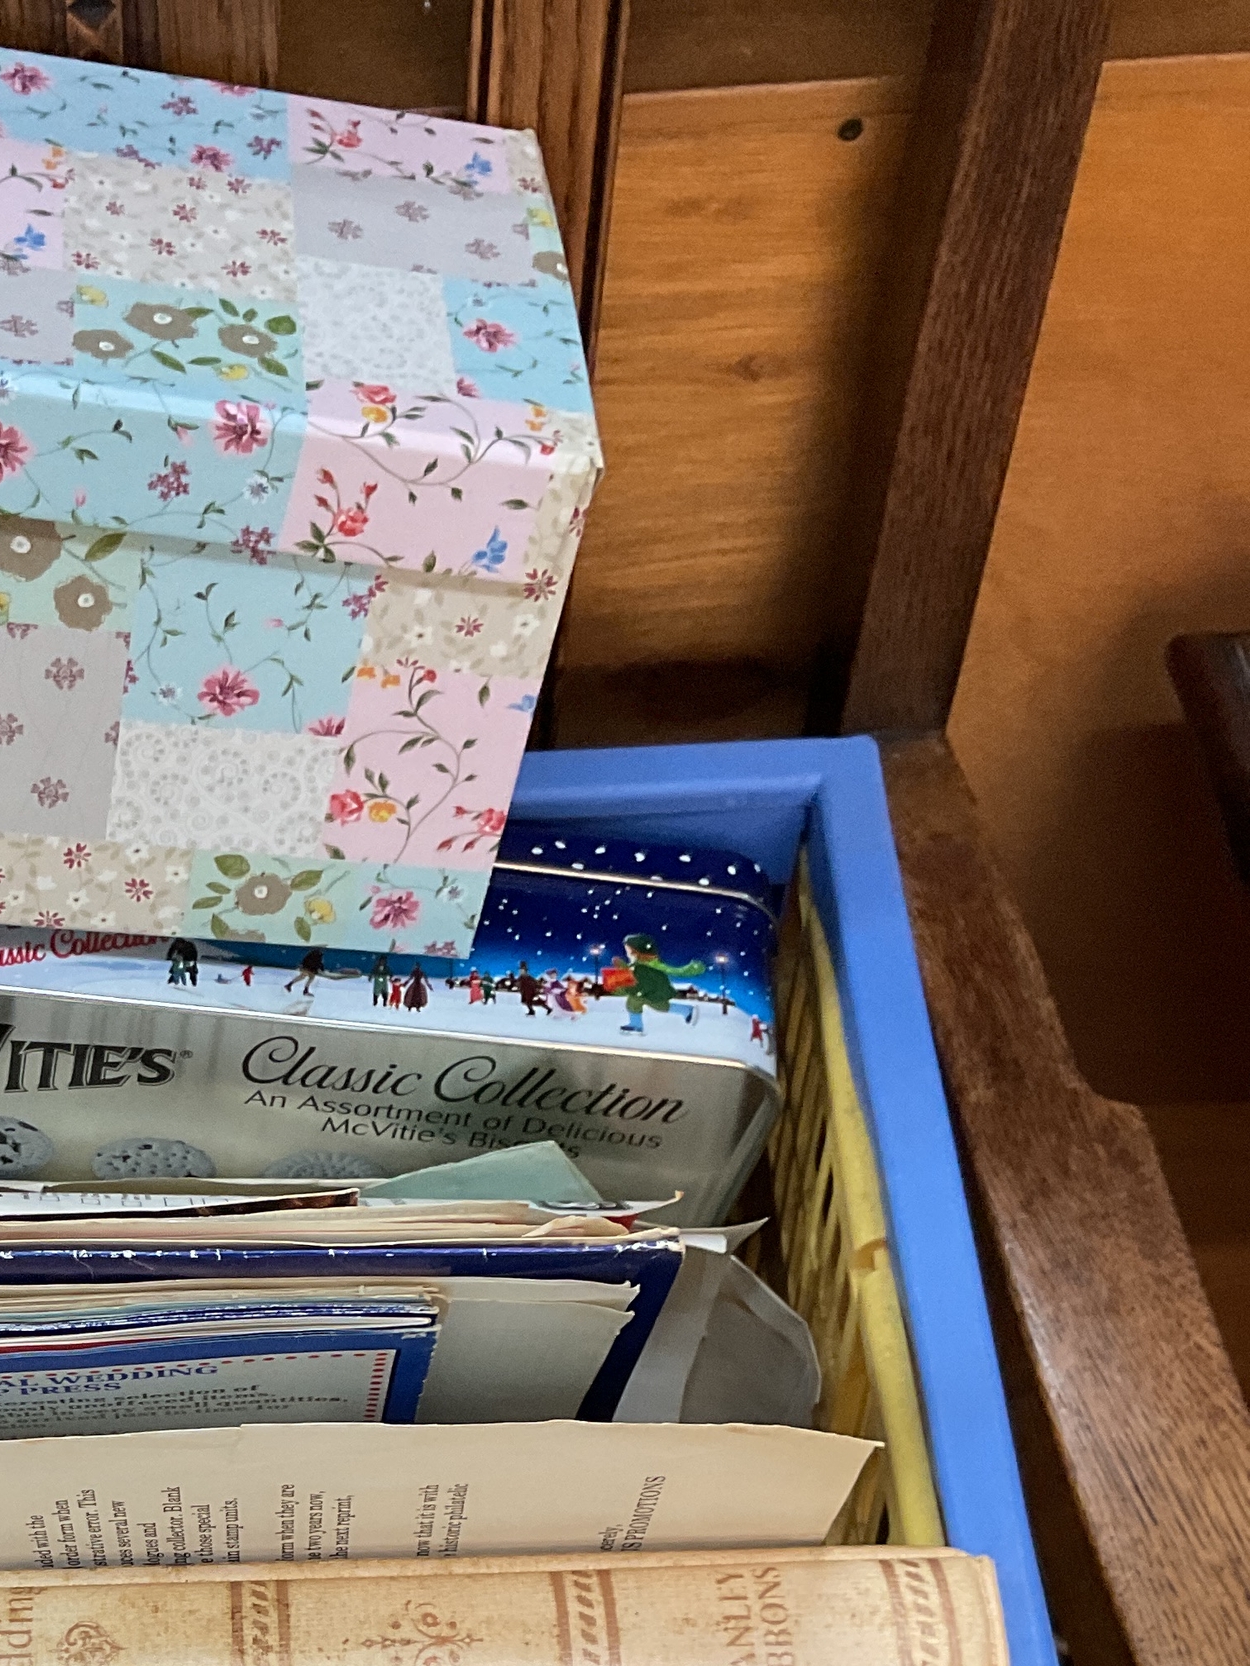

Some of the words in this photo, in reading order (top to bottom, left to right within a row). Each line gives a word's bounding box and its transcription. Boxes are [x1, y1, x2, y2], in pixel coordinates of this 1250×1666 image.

[241, 1035, 423, 1096] Classic
[433, 1055, 690, 1125] Collection
[244, 1090, 287, 1111] An
[296, 1094, 470, 1130] Assortment
[483, 1113, 512, 1133] of
[522, 1117, 663, 1151] Delicious
[321, 1116, 457, 1147] McVitie's
[48, 1365, 219, 1385] WEDDING
[20, 1382, 122, 1395] PRESS
[75, 1488, 97, 1509] This
[160, 1486, 183, 1513] Blank
[280, 1484, 296, 1498] are
[309, 1490, 327, 1511] now,
[417, 1484, 440, 1503] with
[443, 1483, 469, 1521] philatelic
[51, 1499, 72, 1523] when
[111, 1499, 127, 1518] new
[190, 1503, 217, 1533] special
[274, 1499, 300, 1519] they
[331, 1494, 356, 1526] reprint,
[414, 1512, 436, 1520] it
[416, 1503, 437, 1512] is
[624, 1475, 667, 1541] PROMOTIONS
[25, 1514, 45, 1530] the
[84, 1509, 103, 1533] error.
[136, 1522, 157, 1539] and
[274, 1520, 295, 1542] when
[308, 1511, 327, 1535] years
[412, 1520, 435, 1538] that
[27, 1530, 50, 1549] with
[56, 1522, 77, 1543] form
[108, 1518, 132, 1549] several
[166, 1513, 187, 1552] collector.
[224, 1523, 244, 1550] stamp
[303, 1535, 322, 1552] two
[332, 1526, 350, 1546] next
[437, 1521, 462, 1553] historic
[598, 1524, 625, 1551] cerely,
[59, 1543, 81, 1566] order
[85, 1533, 108, 1567] strative
[193, 1534, 214, 1557] those
[416, 1540, 431, 1557] now
